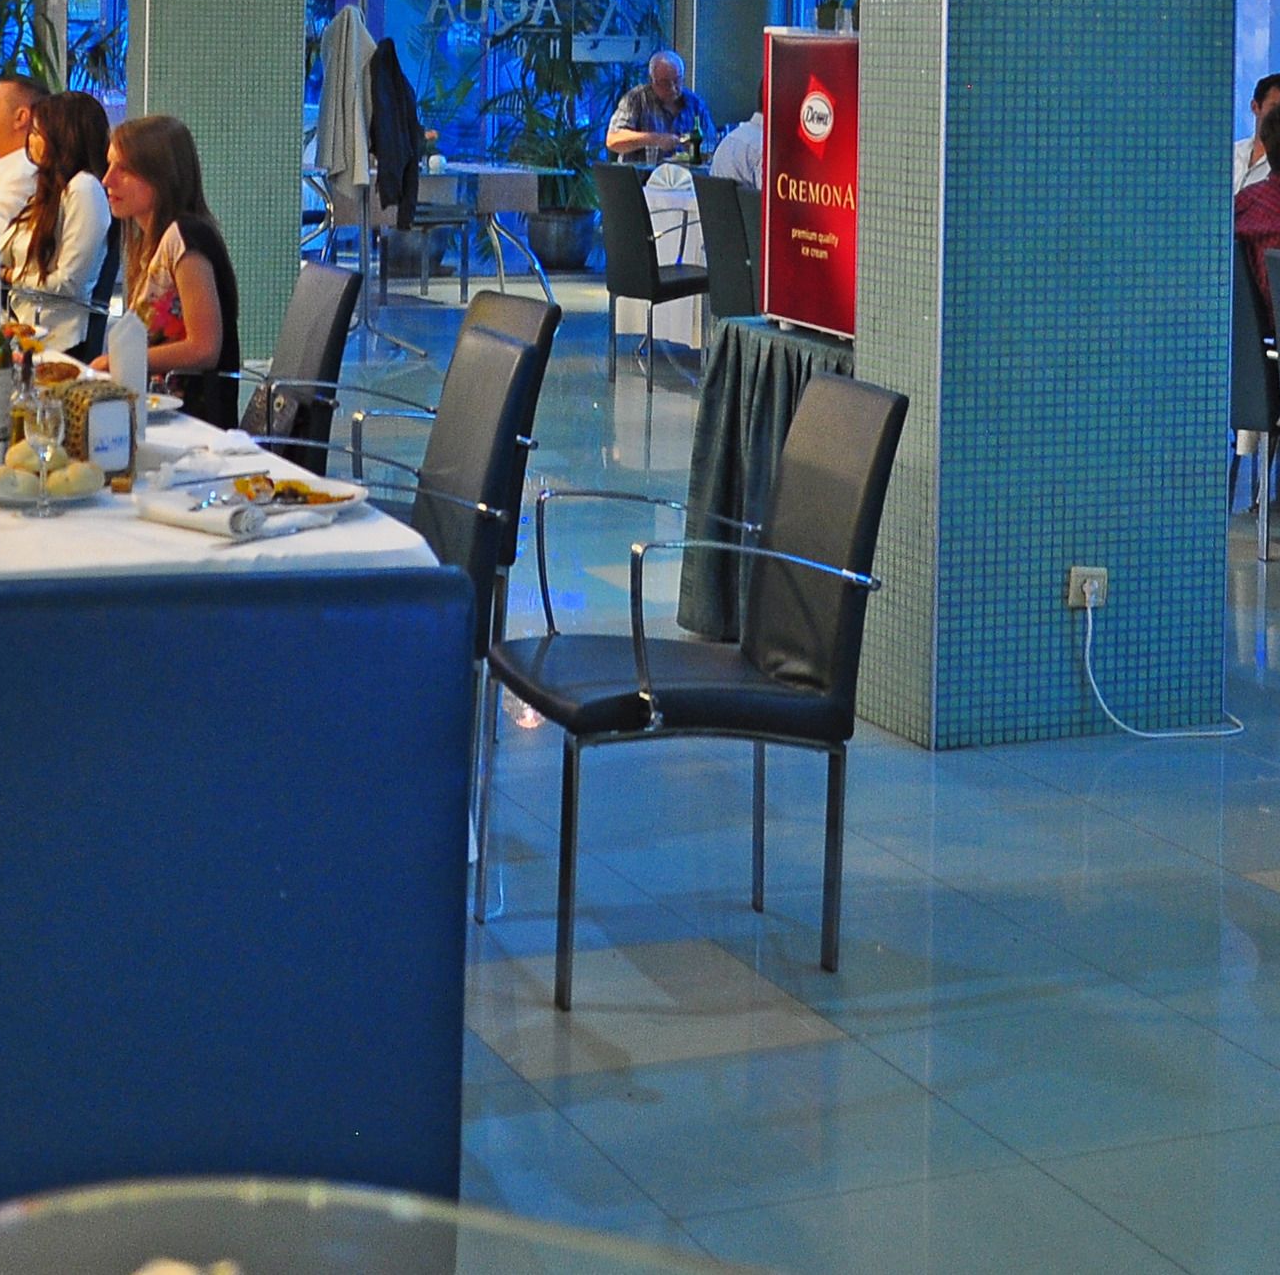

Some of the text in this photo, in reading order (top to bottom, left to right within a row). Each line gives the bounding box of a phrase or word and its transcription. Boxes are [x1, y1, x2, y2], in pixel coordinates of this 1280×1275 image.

[777, 173, 855, 211] CREMONA
[791, 228, 839, 248] premium quality
[810, 247, 829, 260] cream
